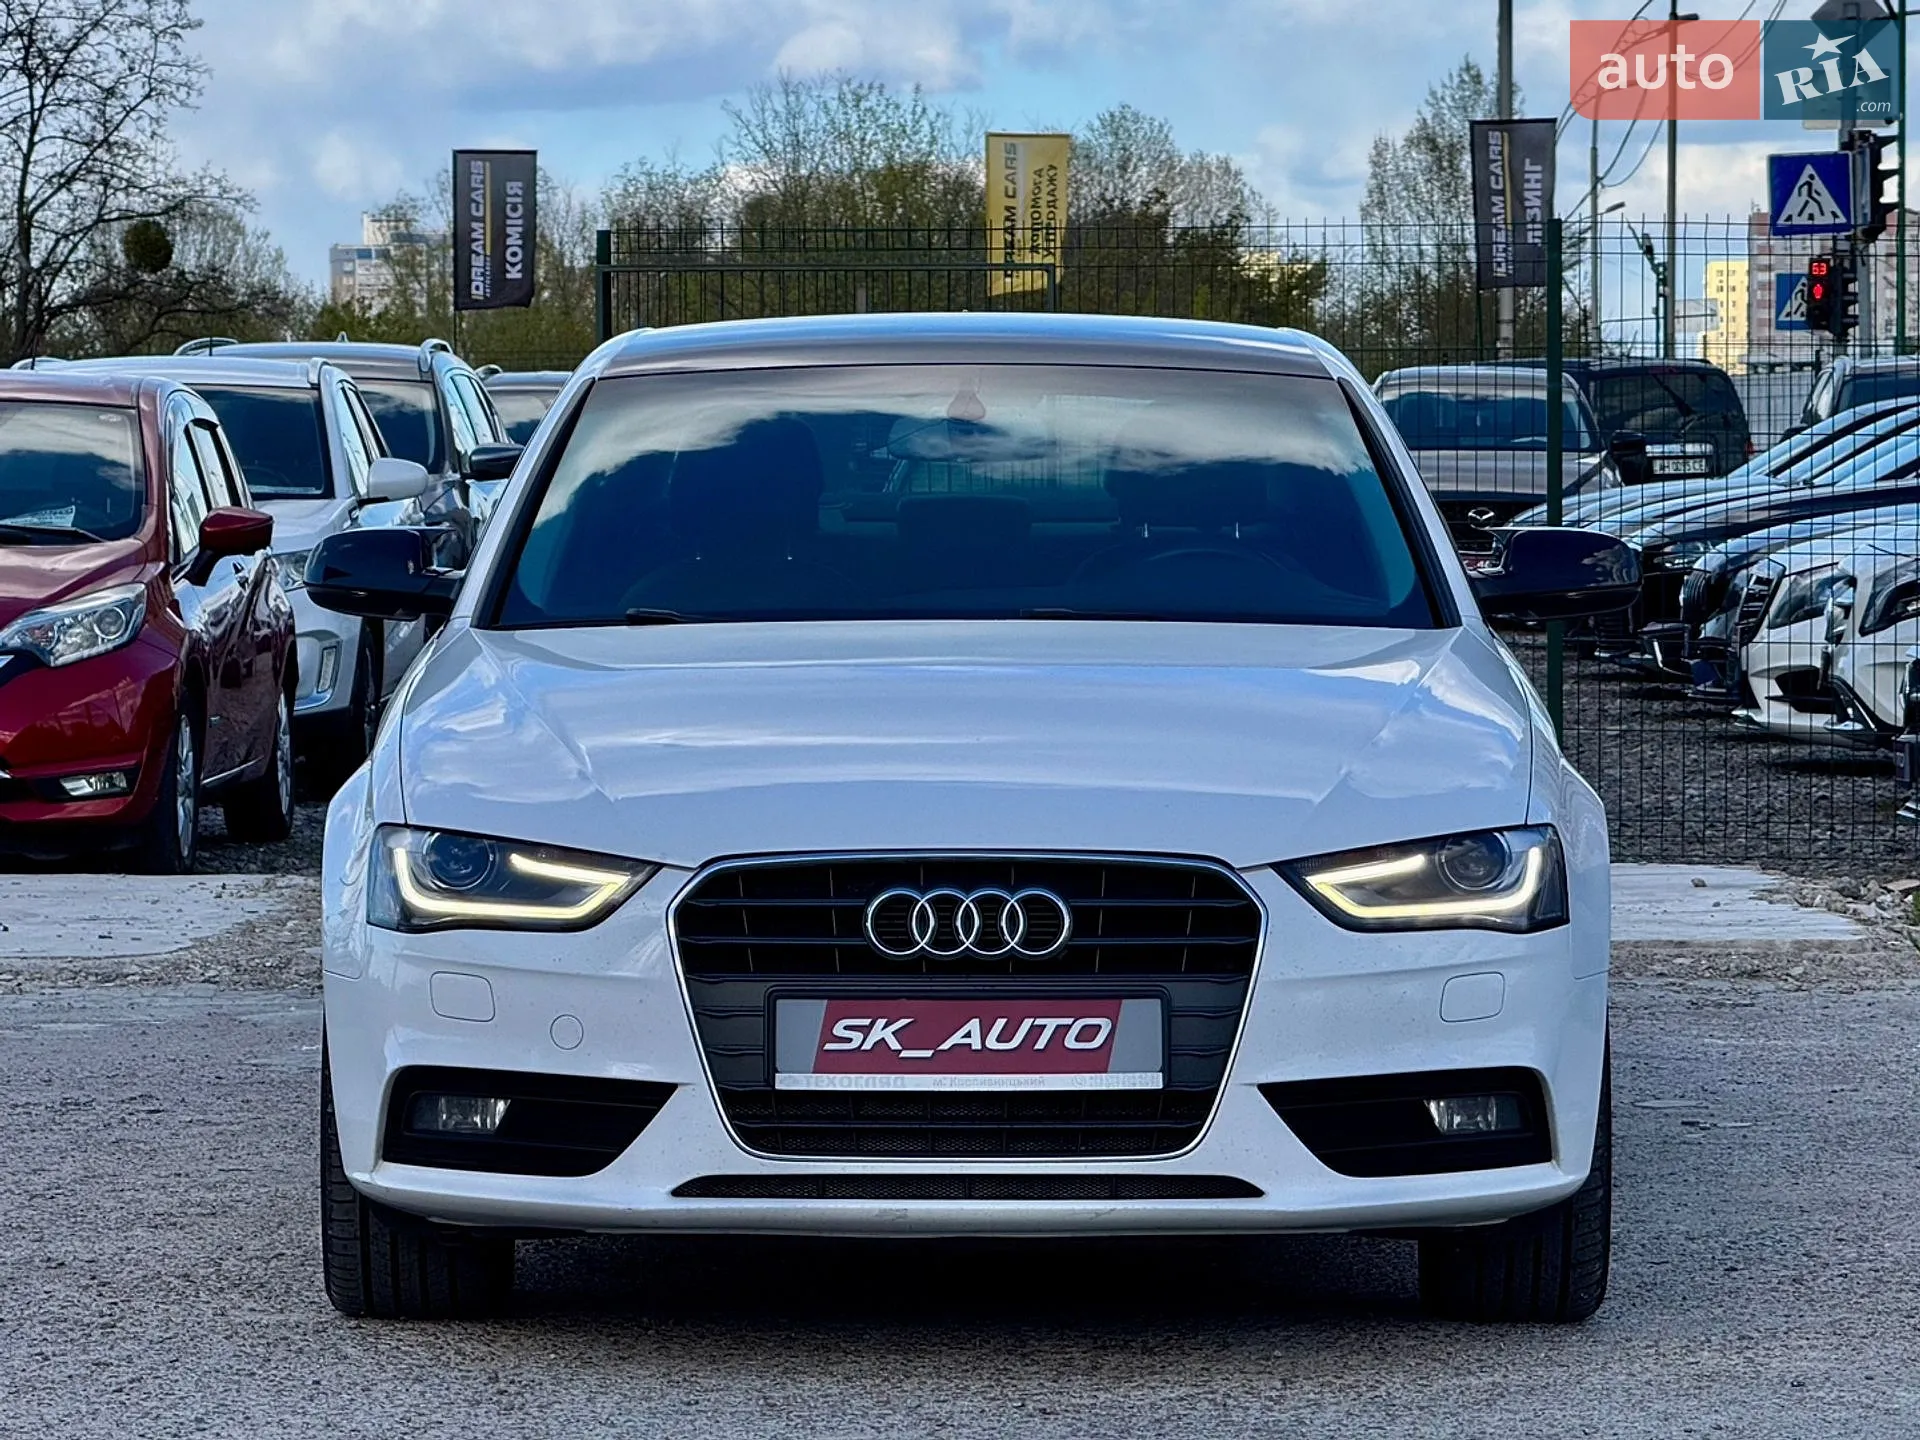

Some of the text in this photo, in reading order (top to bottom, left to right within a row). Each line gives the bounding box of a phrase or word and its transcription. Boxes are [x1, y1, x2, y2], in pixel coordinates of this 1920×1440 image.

[471, 160, 484, 217] CARS
[1004, 142, 1017, 198] CARS
[1488, 130, 1503, 190] CARS
[505, 181, 523, 279] КОМІСІЯ
[1524, 158, 1543, 247] ЛІЗИНГ
[823, 1017, 1112, 1058] SK_AUTO
